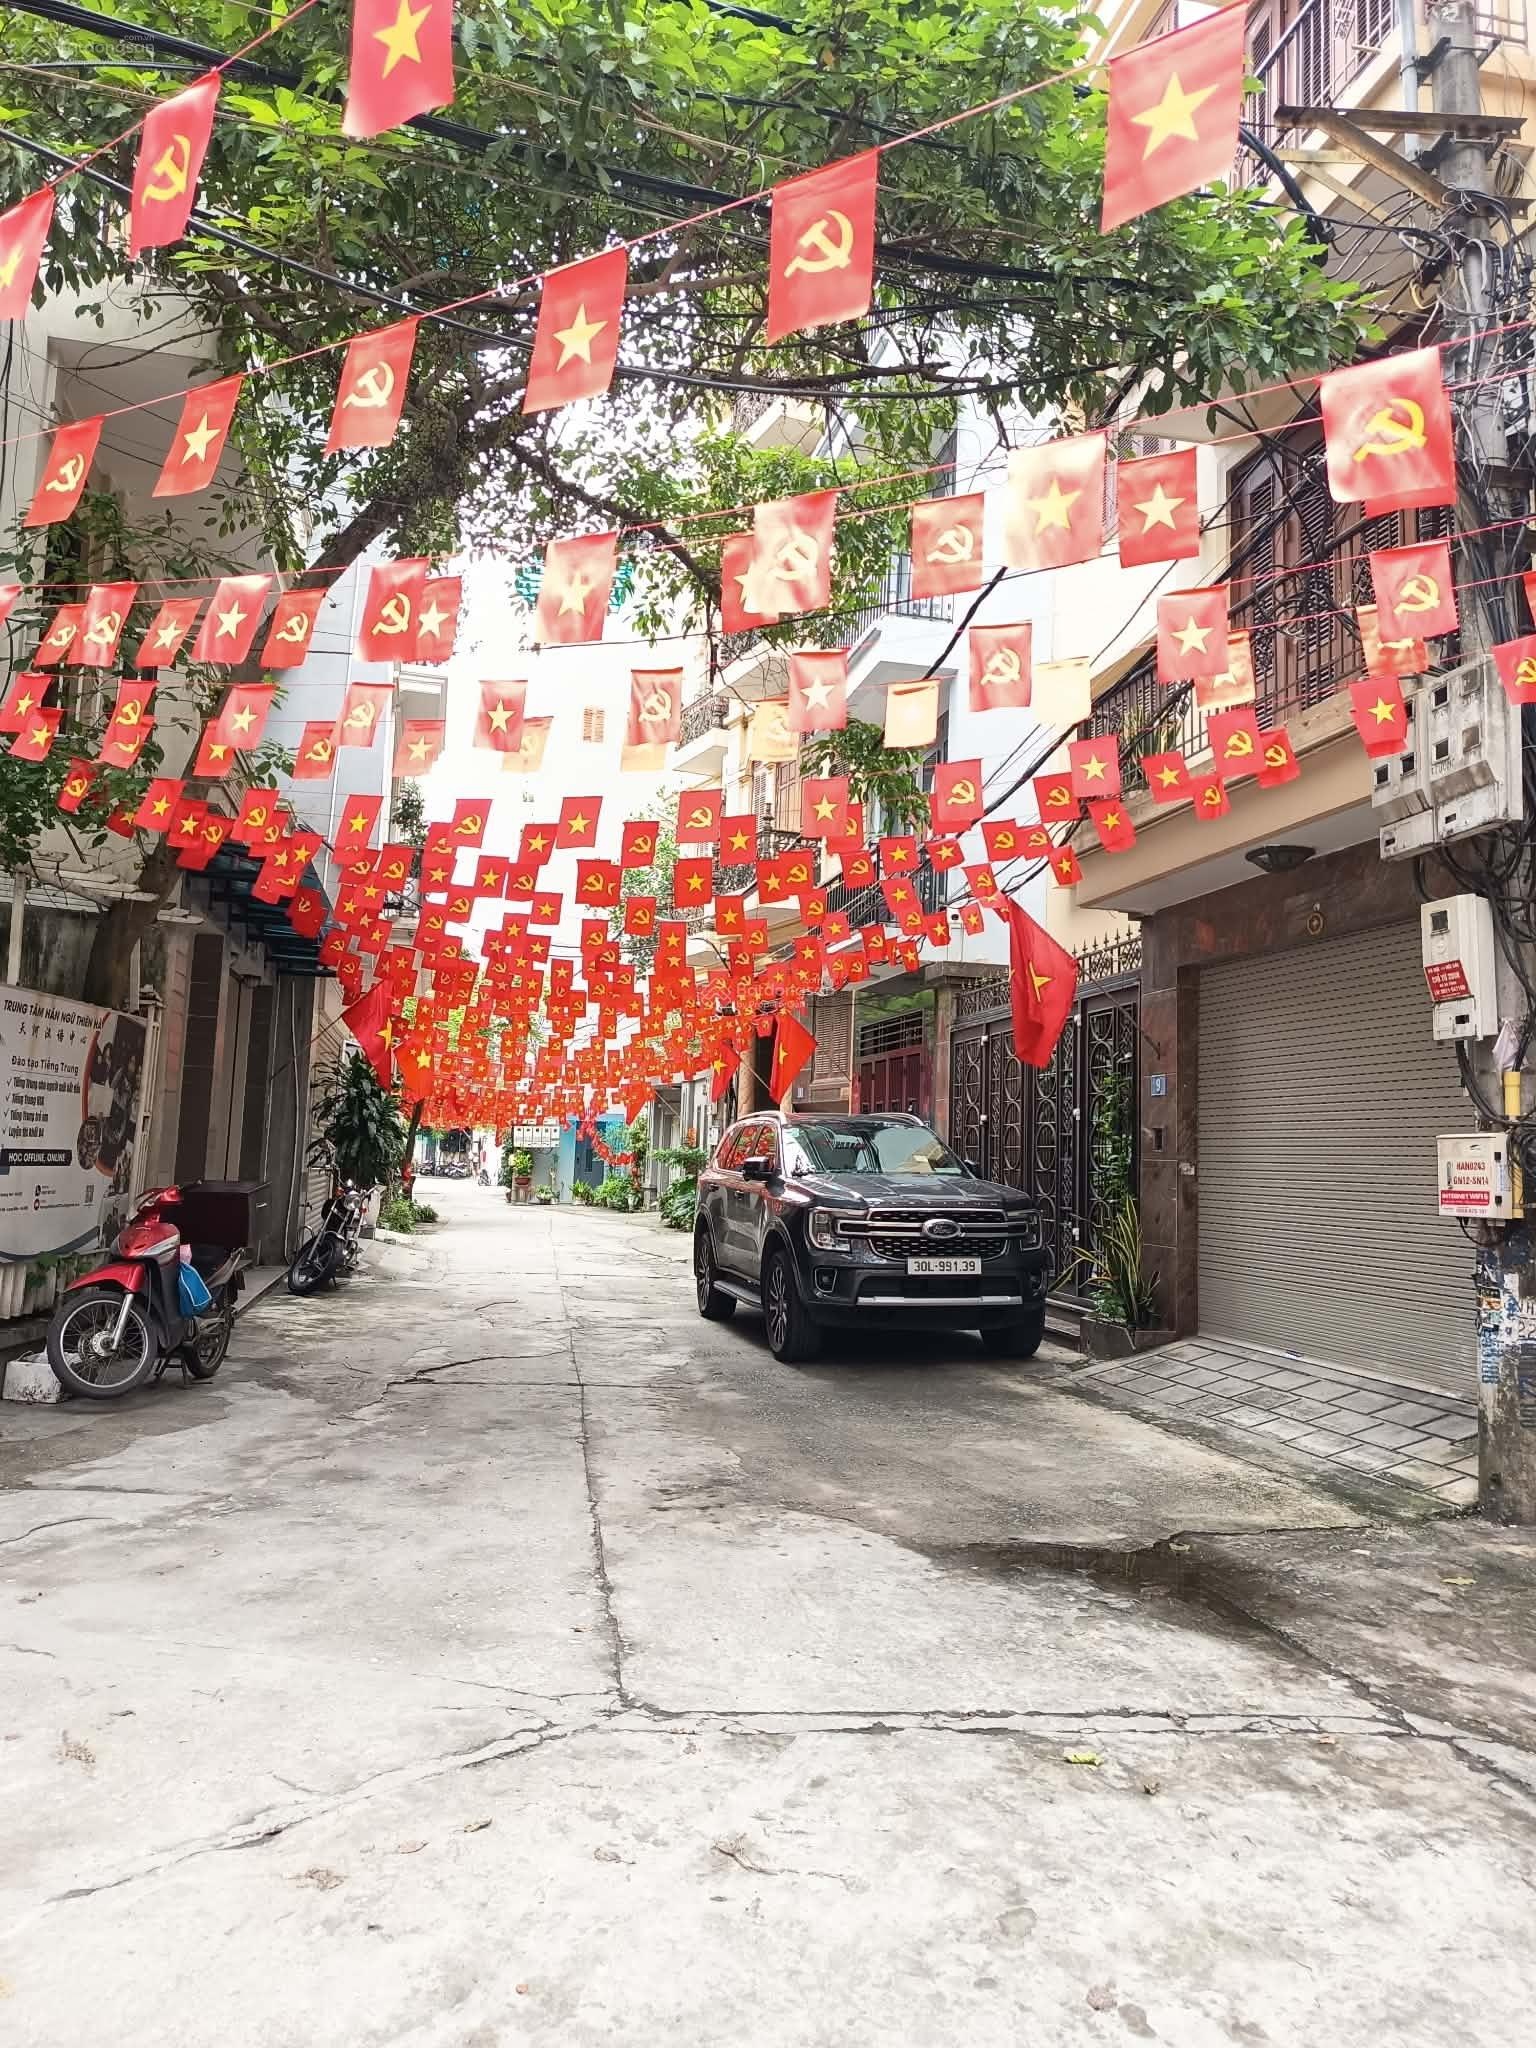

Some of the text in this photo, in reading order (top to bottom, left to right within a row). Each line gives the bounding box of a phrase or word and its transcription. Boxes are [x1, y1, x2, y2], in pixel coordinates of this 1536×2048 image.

[4, 999, 28, 1014] TRUNG
[12, 1055, 79, 1076] Đào tạo Tiếng Trung
[1155, 1078, 1161, 1092] 9
[8, 1153, 23, 1164] HỌC
